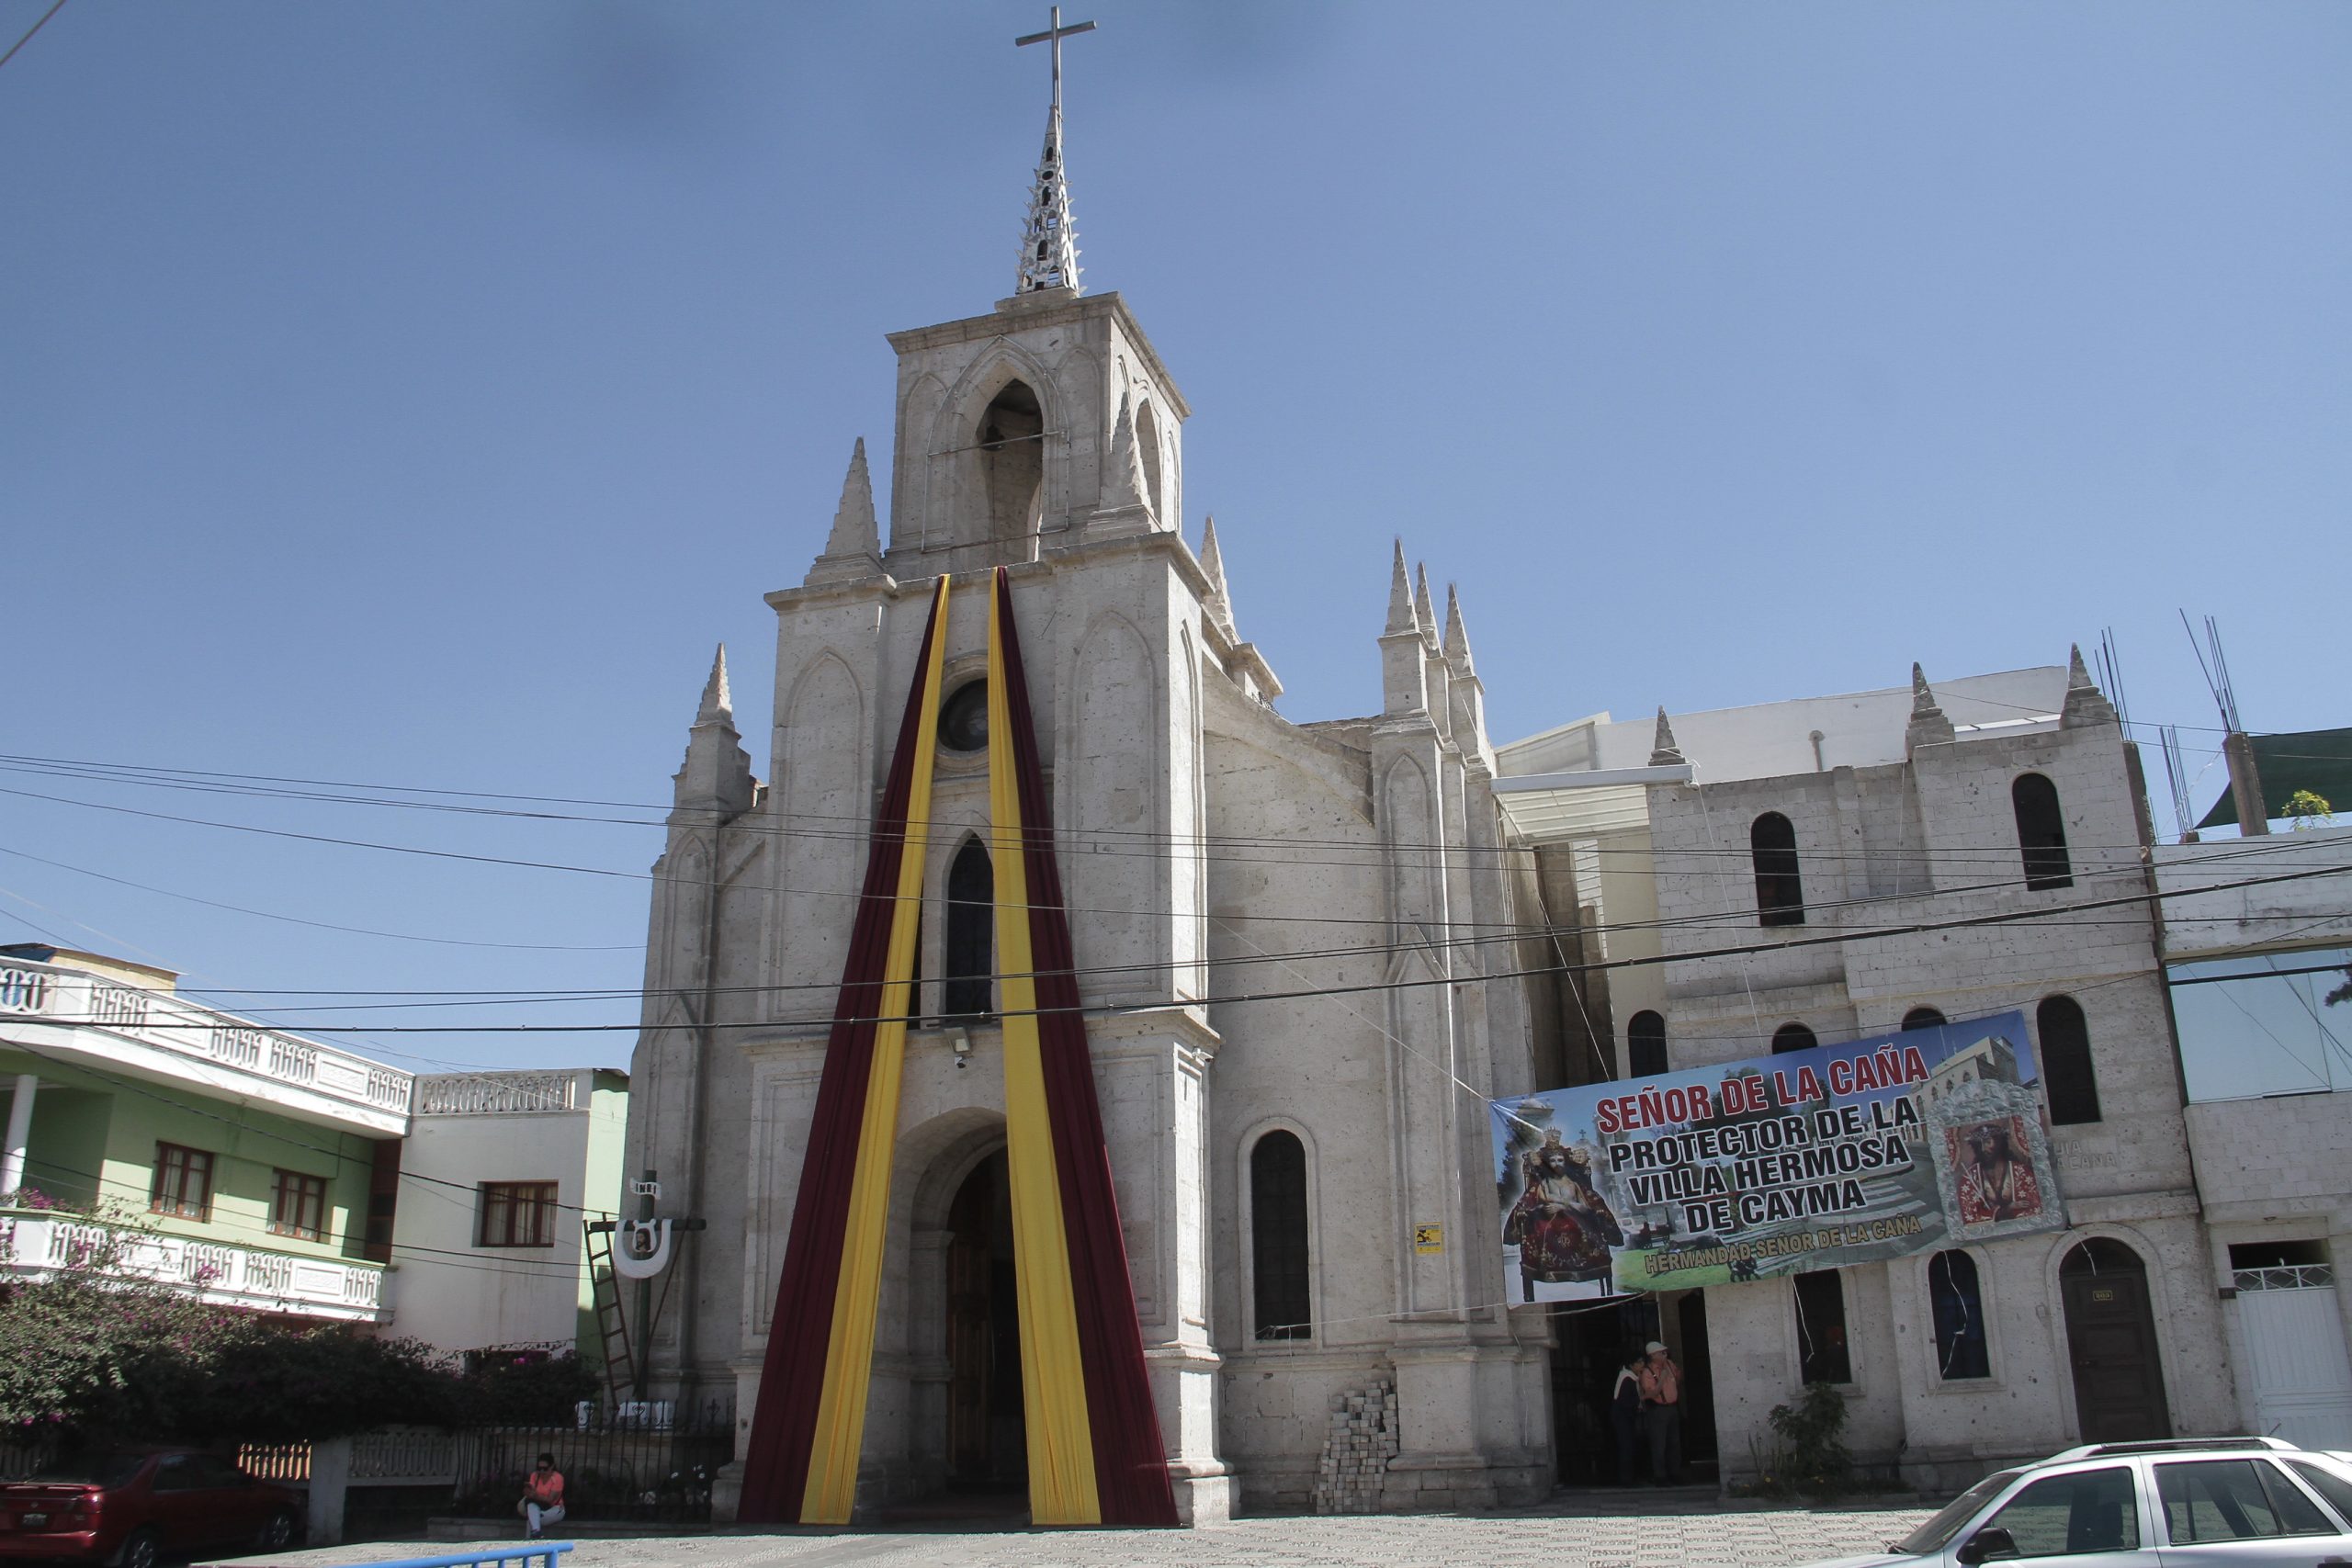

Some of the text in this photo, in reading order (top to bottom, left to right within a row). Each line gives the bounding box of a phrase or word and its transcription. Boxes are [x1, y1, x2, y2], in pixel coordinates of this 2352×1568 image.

[1597, 1043, 1929, 1134] SEÑOR DE LA CAÑA
[1609, 1095, 1919, 1173] PROTECTOR DE LA
[636, 1182, 656, 1195] INRI
[1627, 1134, 1913, 1206] VILLA HERMOSA
[1683, 1178, 1868, 1235] DE CAYMA
[1645, 1213, 1922, 1274] HERMANDAD SEÑOR DE LA CAÑA
